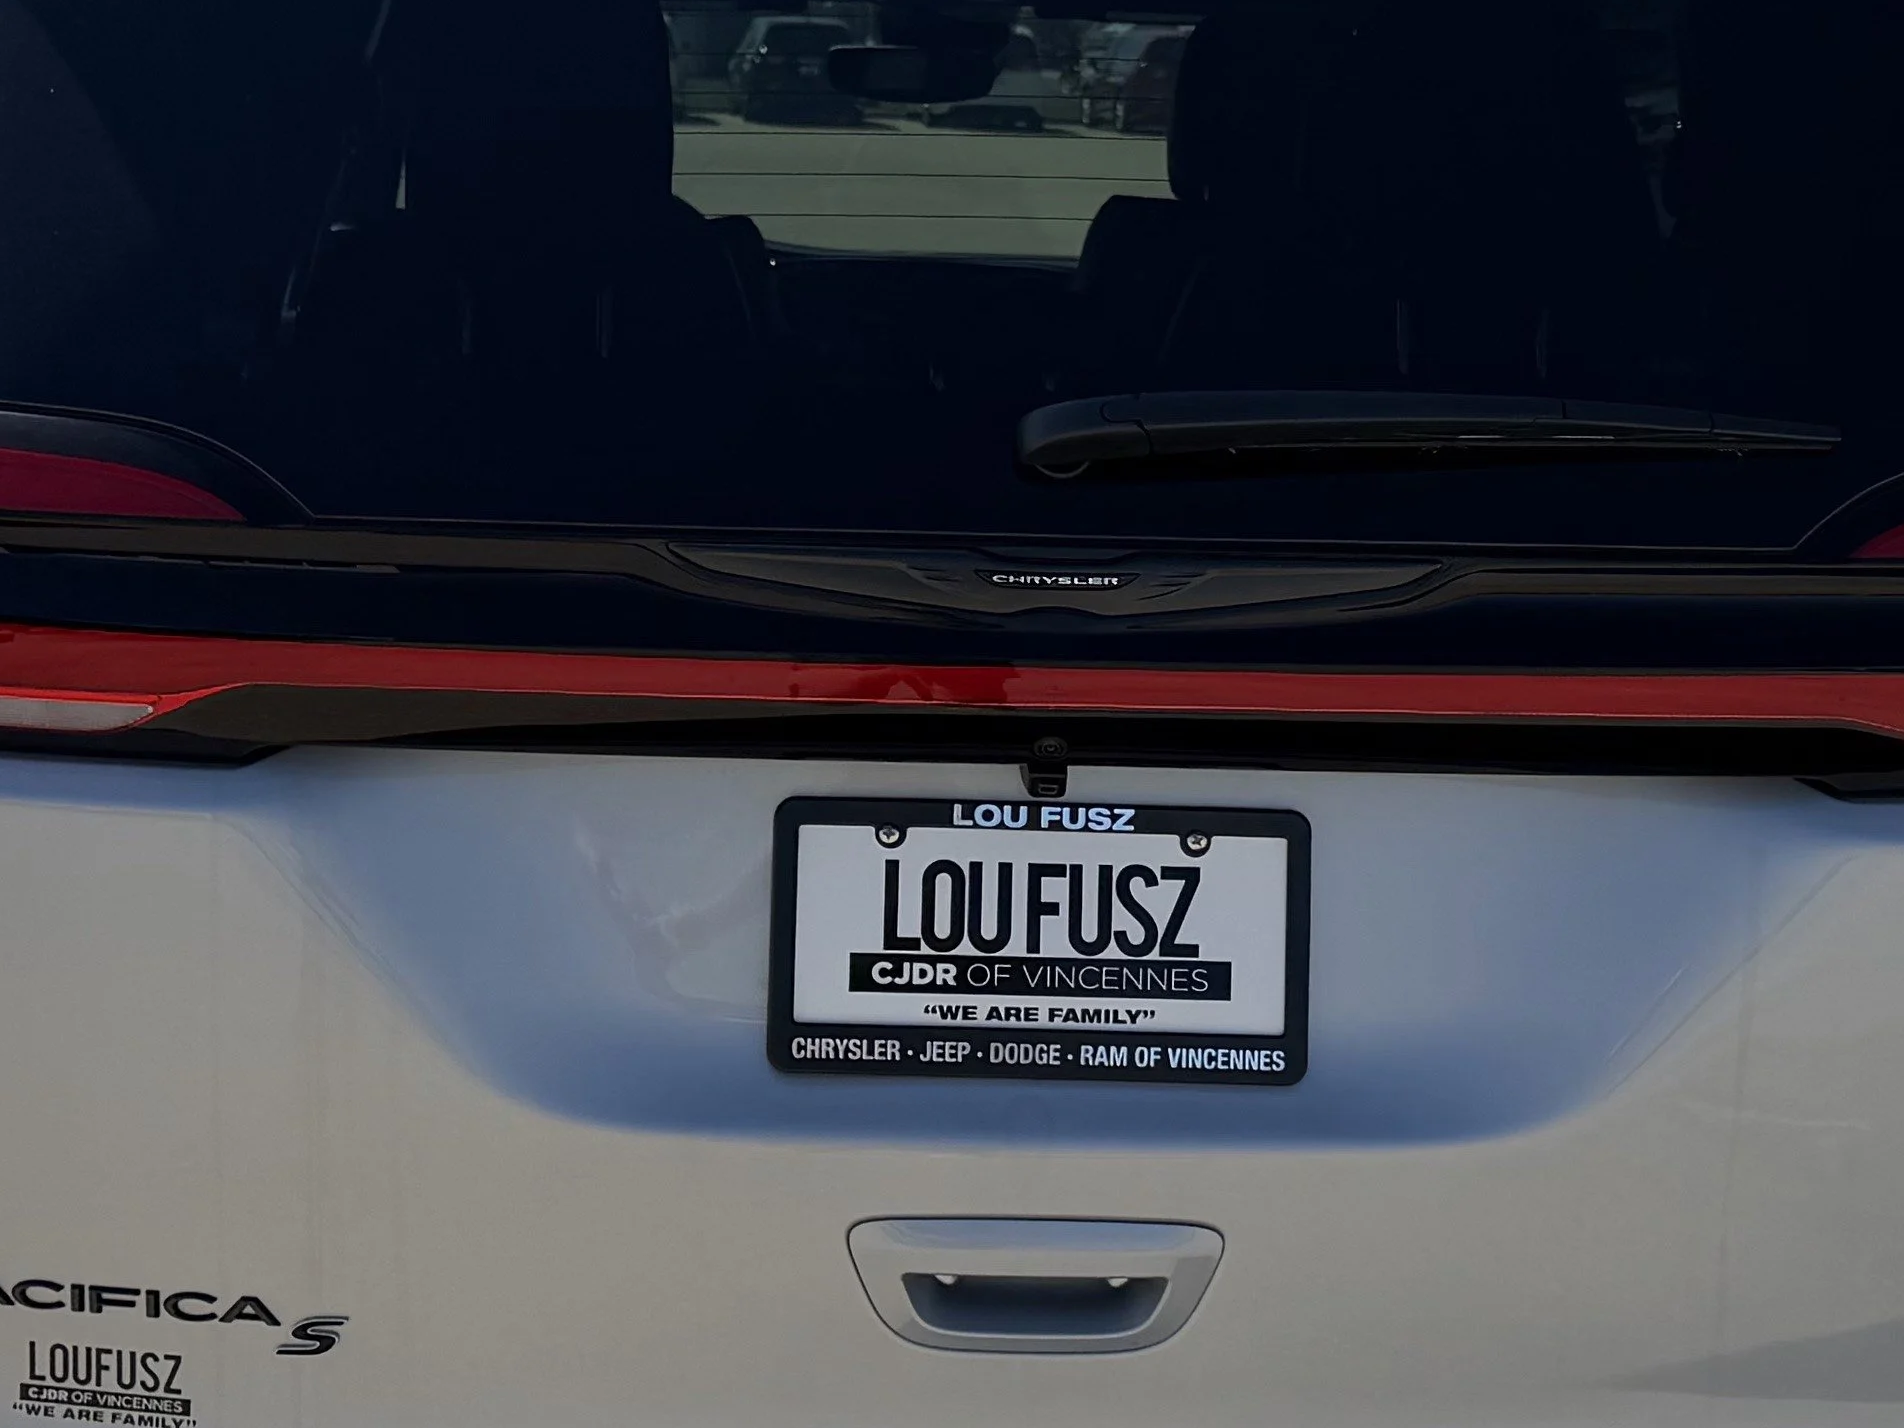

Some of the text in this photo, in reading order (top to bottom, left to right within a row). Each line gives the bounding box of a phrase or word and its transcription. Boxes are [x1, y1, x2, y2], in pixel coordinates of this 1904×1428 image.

[992, 574, 1119, 585] CHRYSLER
[953, 803, 1136, 833] LOU FUSZ
[882, 859, 1202, 959] LOU FUSZ
[871, 961, 1209, 992] CJDR OF VINCENNES
[923, 1004, 1156, 1026] “WE ARE FAMILY”
[791, 1037, 1286, 1072] CHRYSLER JEEP DODGE RAM OF VINCENNES
[276, 1315, 350, 1356] S
[27, 1387, 183, 1413] CJDR OF VINCENNES
[62, 1408, 104, 1423] ARE
